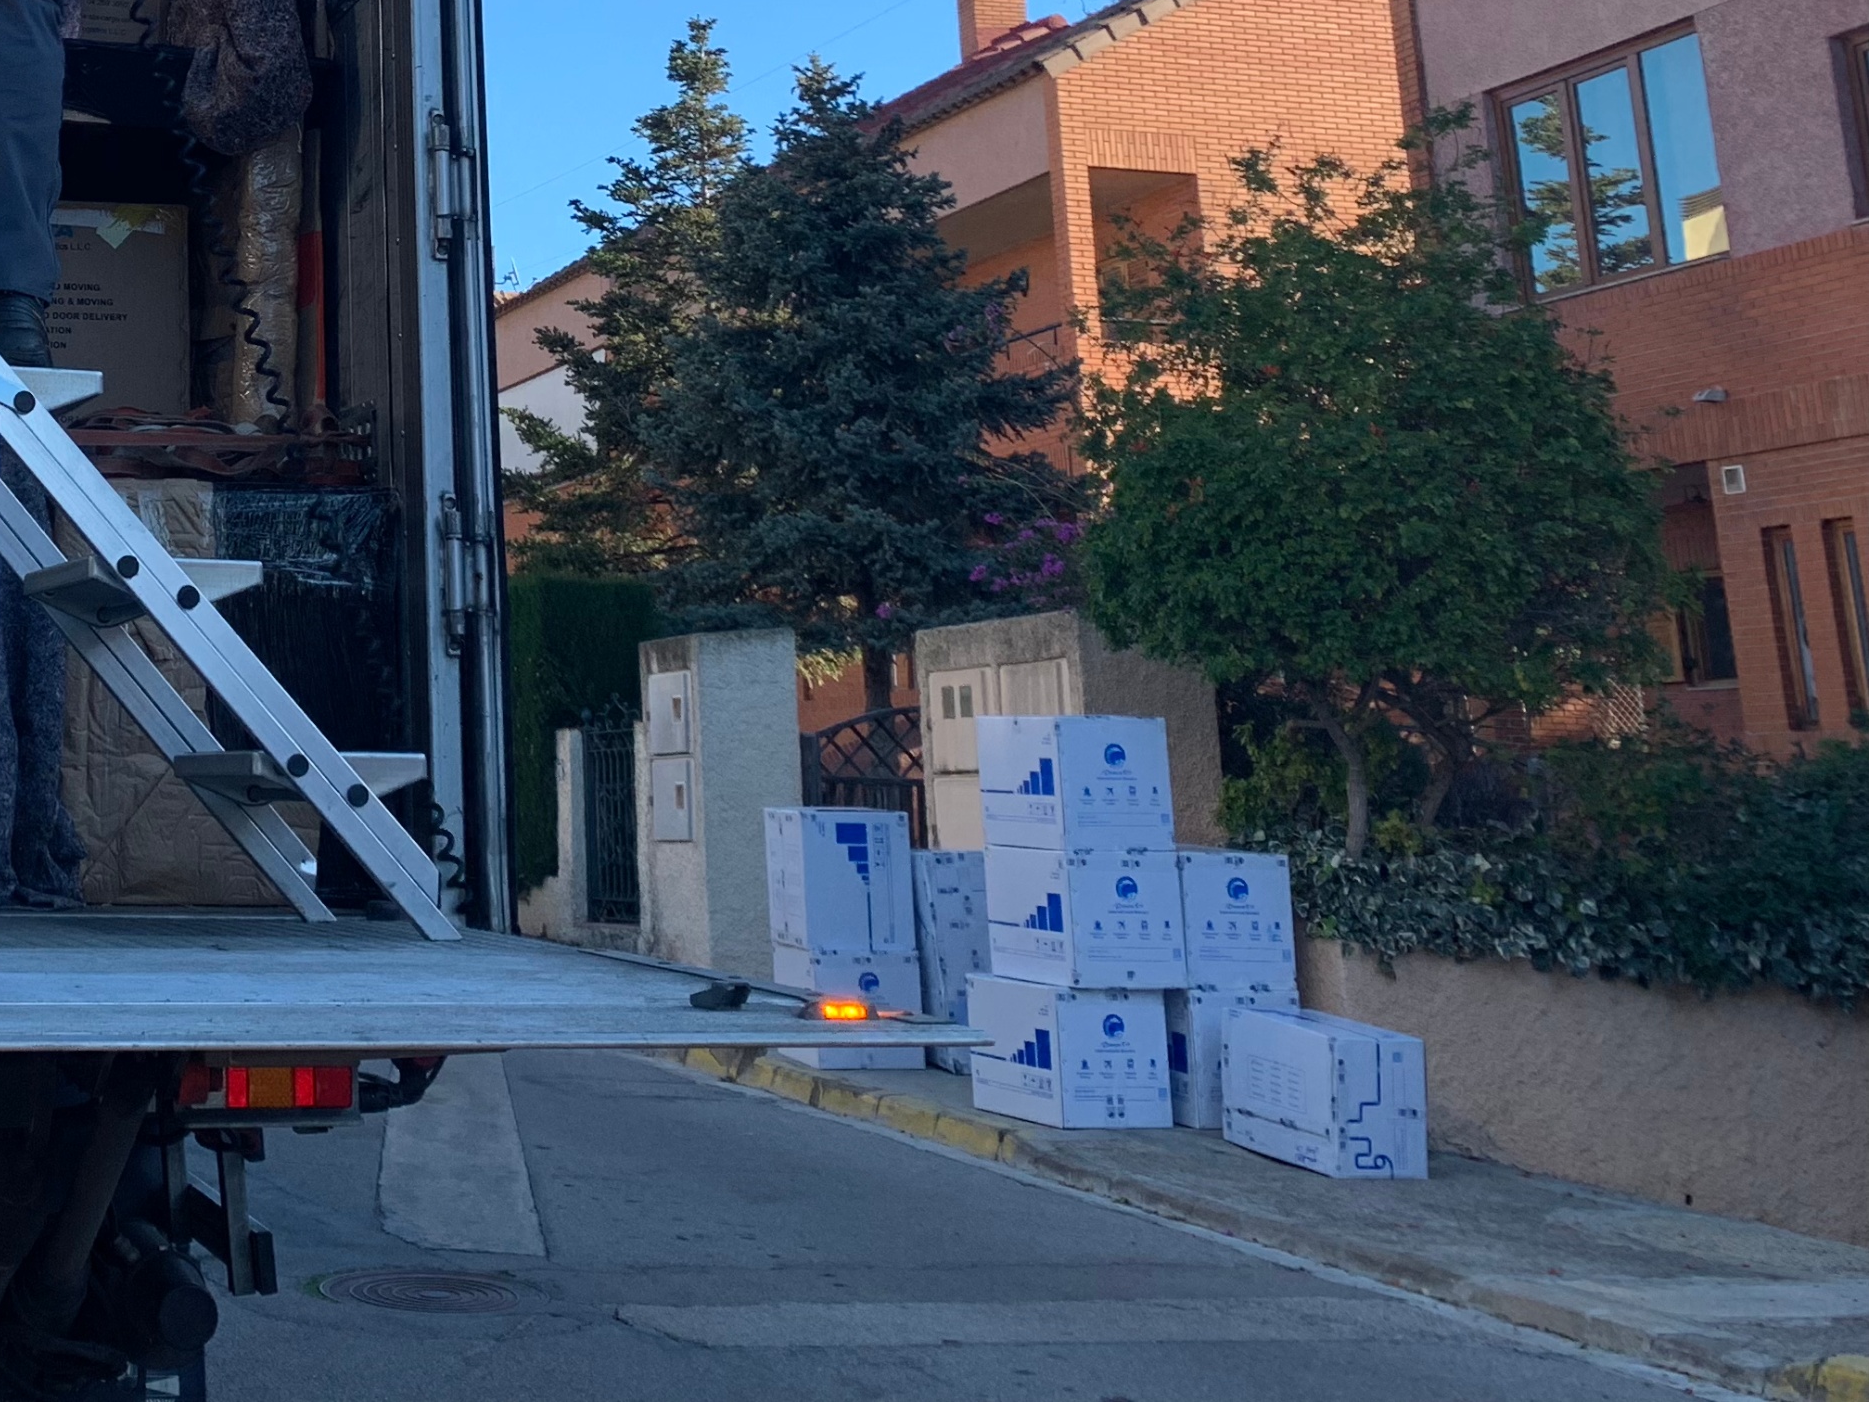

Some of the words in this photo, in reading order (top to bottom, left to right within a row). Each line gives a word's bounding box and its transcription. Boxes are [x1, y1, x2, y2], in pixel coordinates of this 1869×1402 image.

[62, 282, 101, 292] MOVING
[76, 298, 114, 307] MOVING
[52, 311, 80, 320] DOOR
[82, 312, 129, 322] DELIVERY
